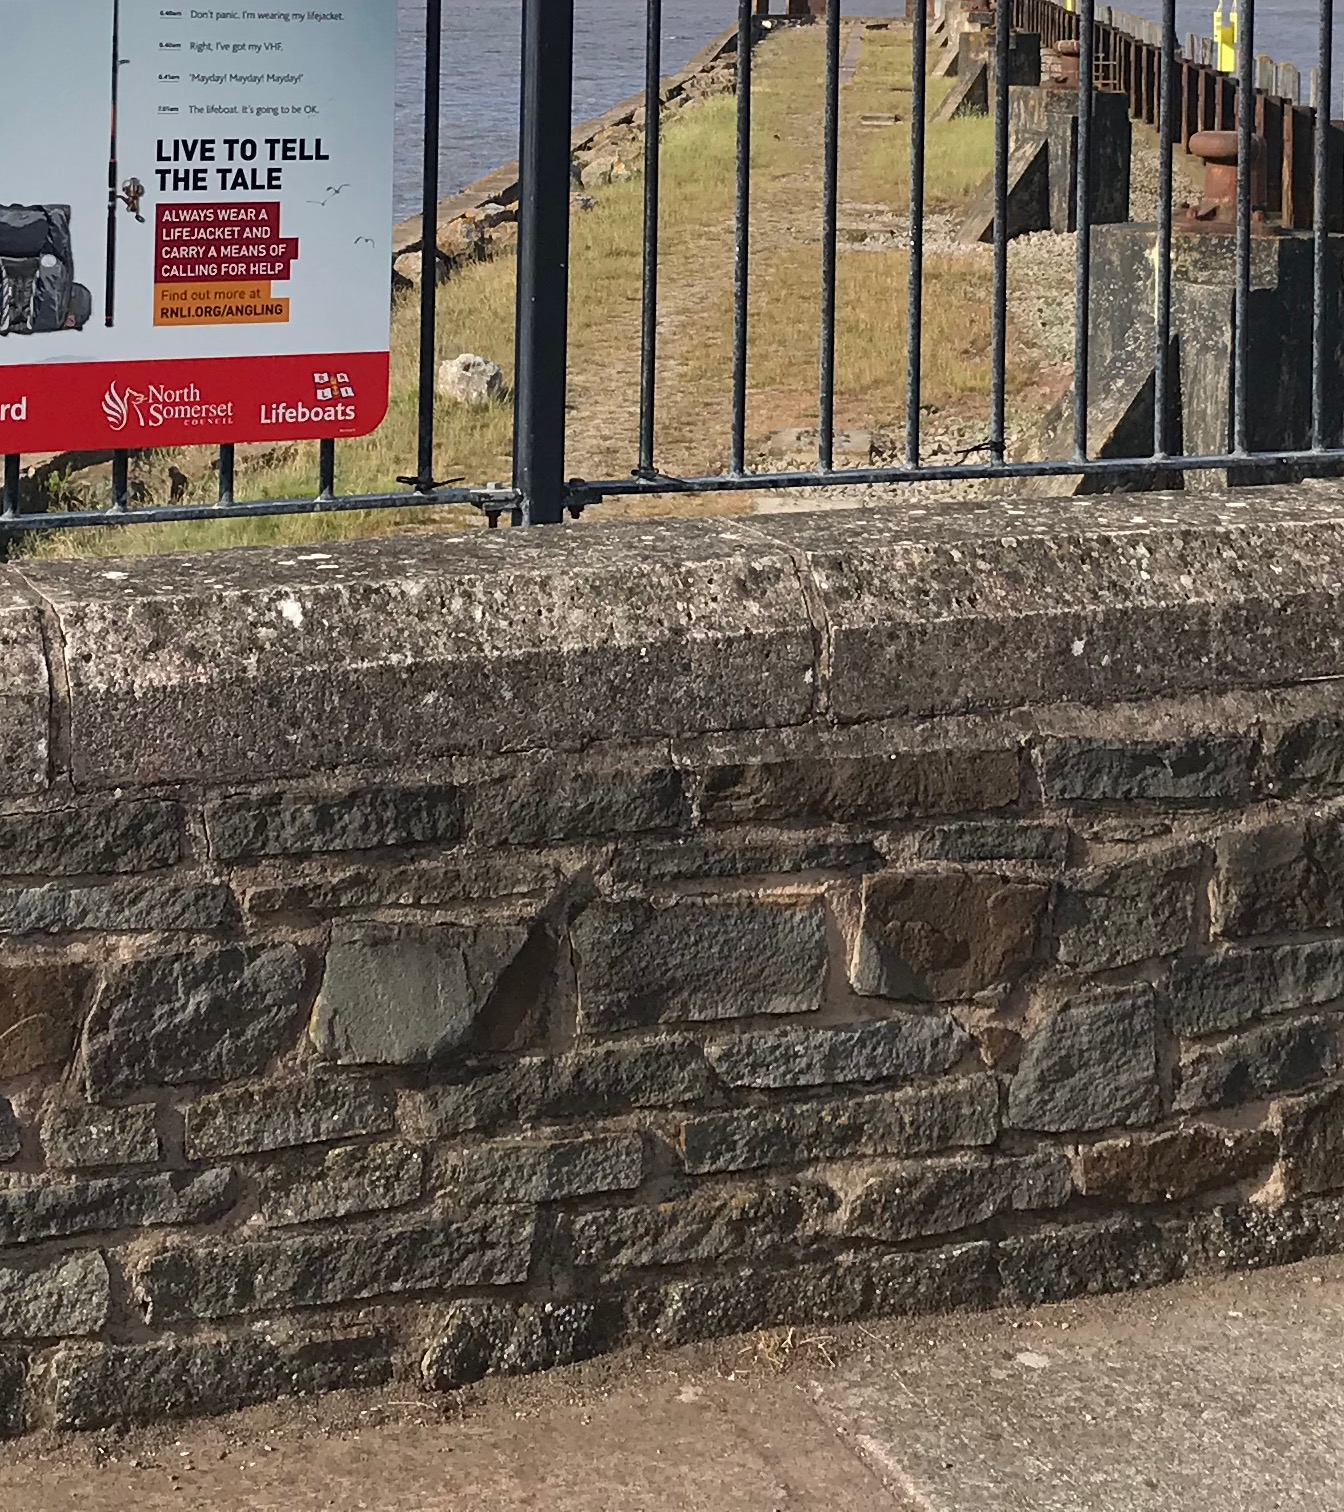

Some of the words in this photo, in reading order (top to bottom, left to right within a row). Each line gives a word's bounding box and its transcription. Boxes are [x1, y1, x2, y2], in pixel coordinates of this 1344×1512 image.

[190, 9, 214, 20] Don't
[216, 11, 240, 21] panic.
[242, 10, 255, 20] I'm
[257, 11, 290, 22] wearing
[292, 13, 306, 22] my
[307, 11, 345, 22] lifejacket.
[216, 42, 230, 51] I've
[232, 43, 246, 53] got
[248, 44, 262, 54] my
[229, 74, 265, 85] Mayday!
[189, 105, 205, 114] The
[242, 105, 254, 114] It's
[256, 107, 279, 117] going
[280, 106, 290, 114] to
[292, 106, 302, 114] be
[156, 139, 215, 162] LIVE
[223, 138, 258, 161] TO
[265, 138, 329, 161] TELL
[155, 168, 208, 191] THE
[216, 167, 282, 190] TALE
[162, 209, 214, 222] ALWAYS
[217, 208, 256, 221] WEAR
[258, 208, 268, 221] A
[162, 227, 240, 241] LIFEJACKET
[243, 226, 271, 239] AND
[161, 245, 206, 259] CARRY
[208, 245, 218, 258] A
[220, 244, 267, 257] MEANS
[269, 244, 287, 257] OF
[161, 264, 218, 277] CALLING
[221, 263, 246, 276] FOR
[249, 263, 284, 275] HELP
[161, 289, 188, 301] Find
[190, 290, 211, 301] out
[214, 290, 246, 300] more
[249, 287, 261, 300] at
[160, 304, 283, 319] RNLI.ORG/ANGLING
[148, 383, 201, 404] North
[148, 401, 234, 427] Somerset
[260, 401, 356, 424] Lifeboats
[183, 417, 234, 426] COUNCIL
